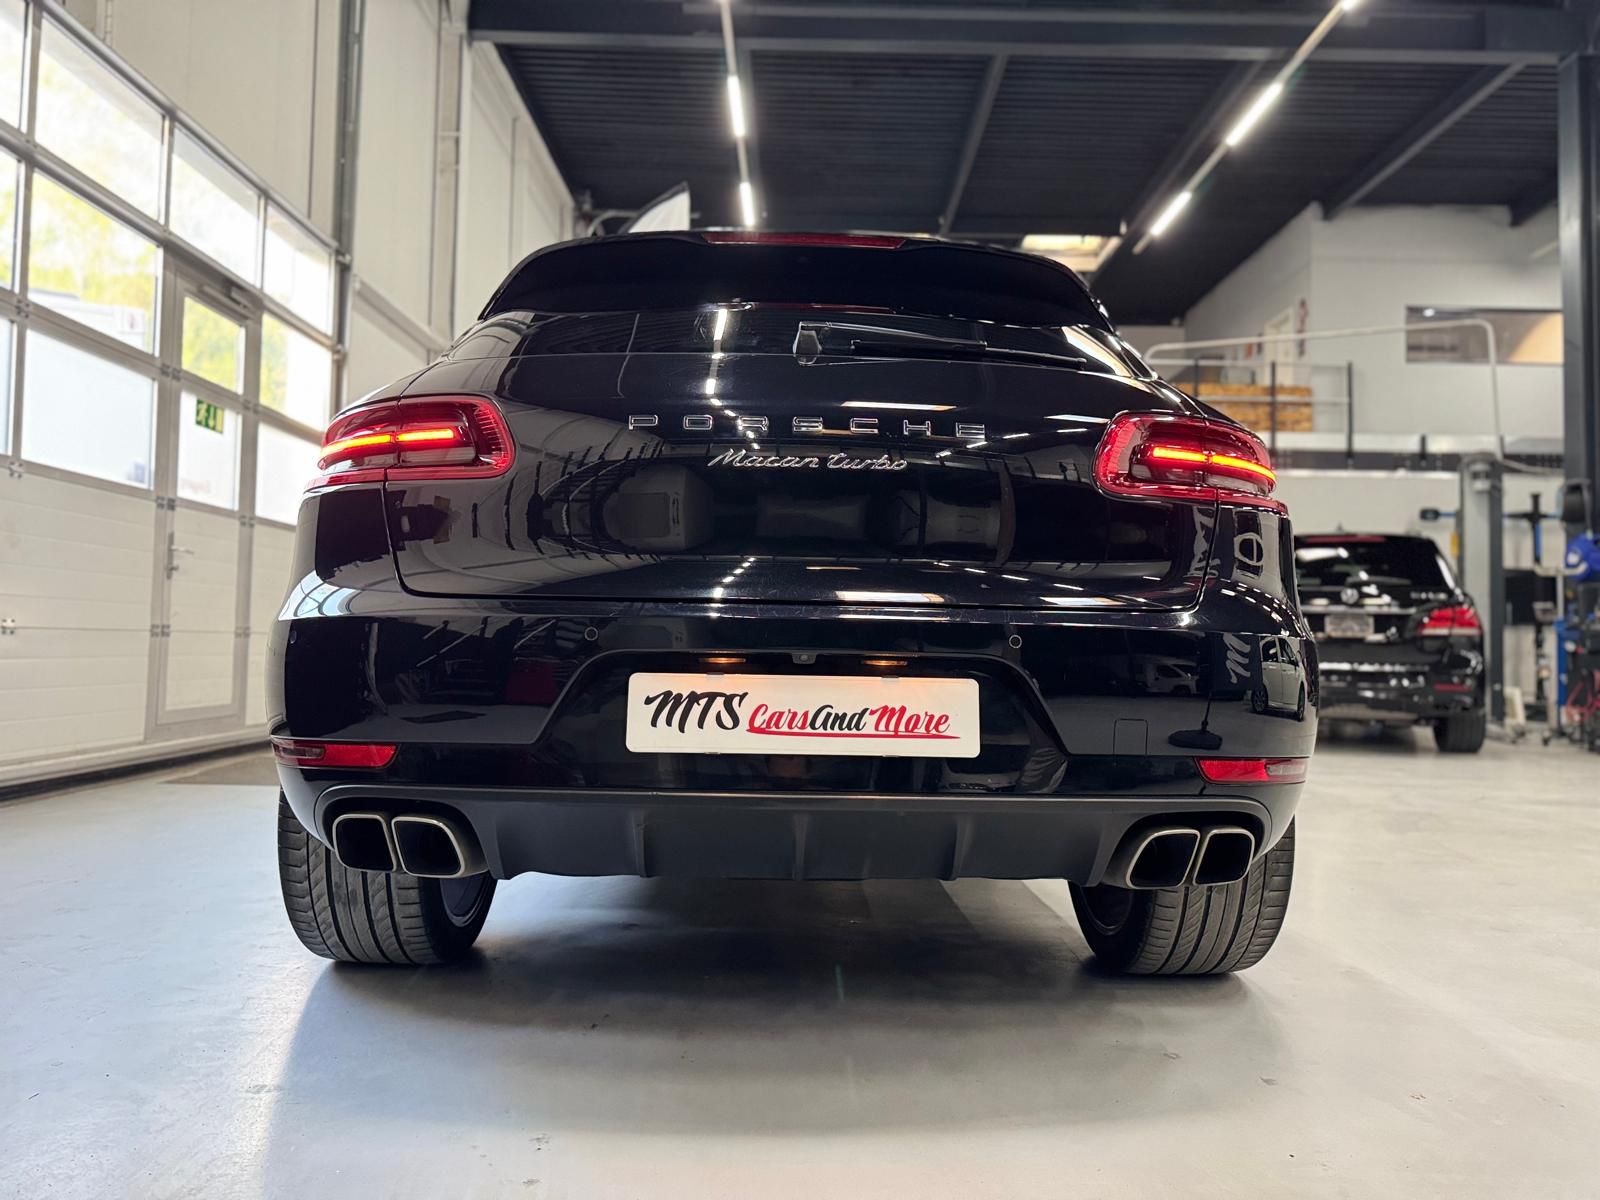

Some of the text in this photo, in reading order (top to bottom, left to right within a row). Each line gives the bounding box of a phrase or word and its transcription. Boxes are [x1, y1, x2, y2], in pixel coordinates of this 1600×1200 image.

[628, 414, 985, 438] PORSCHE
[708, 448, 907, 471] Macan turbo
[644, 690, 748, 734] MTS
